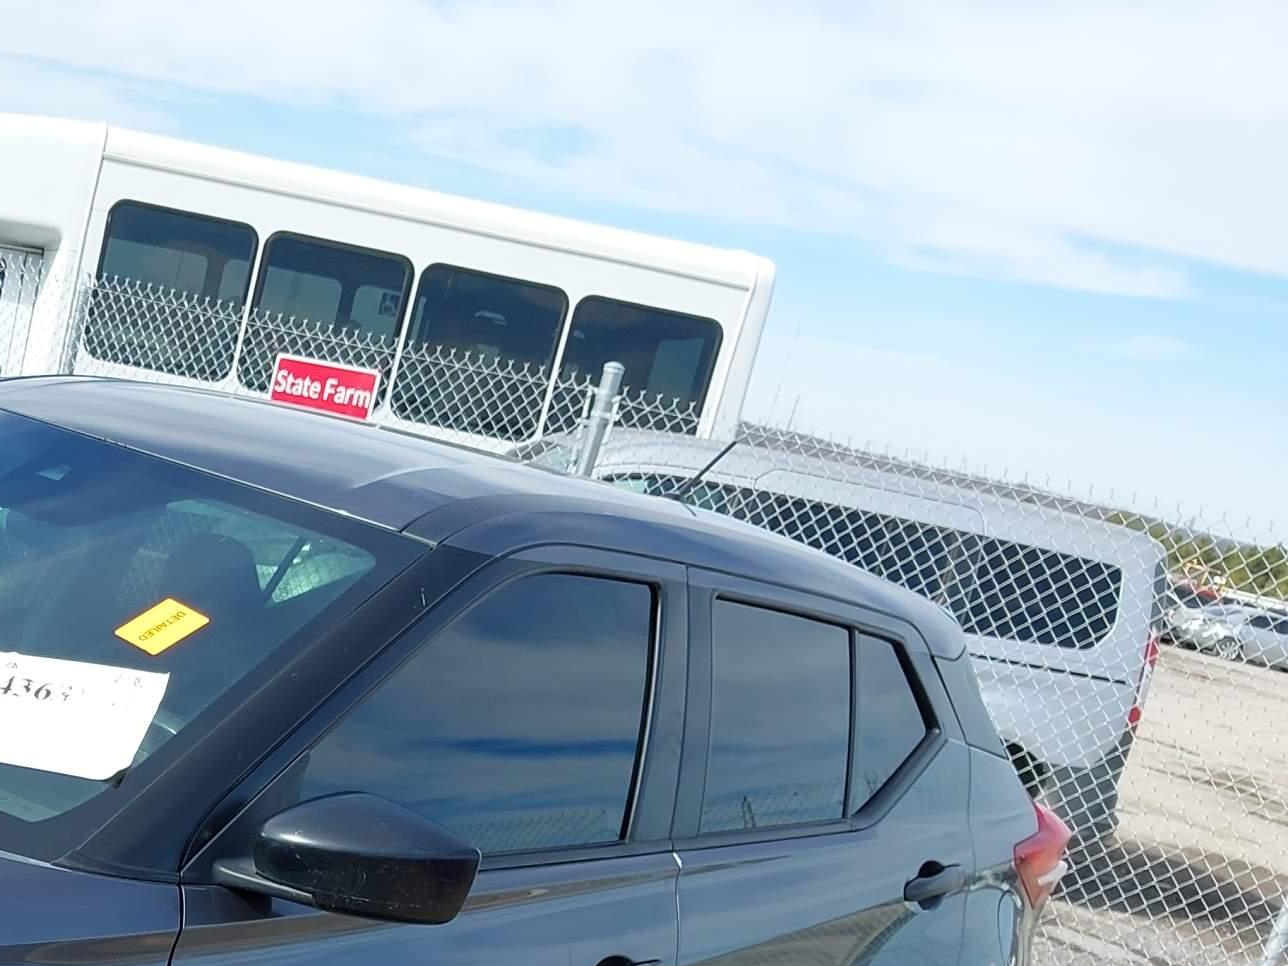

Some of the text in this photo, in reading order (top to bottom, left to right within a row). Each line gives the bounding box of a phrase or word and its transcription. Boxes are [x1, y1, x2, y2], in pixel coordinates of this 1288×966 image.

[274, 368, 372, 409] State Farm
[137, 610, 187, 642] DETAILED
